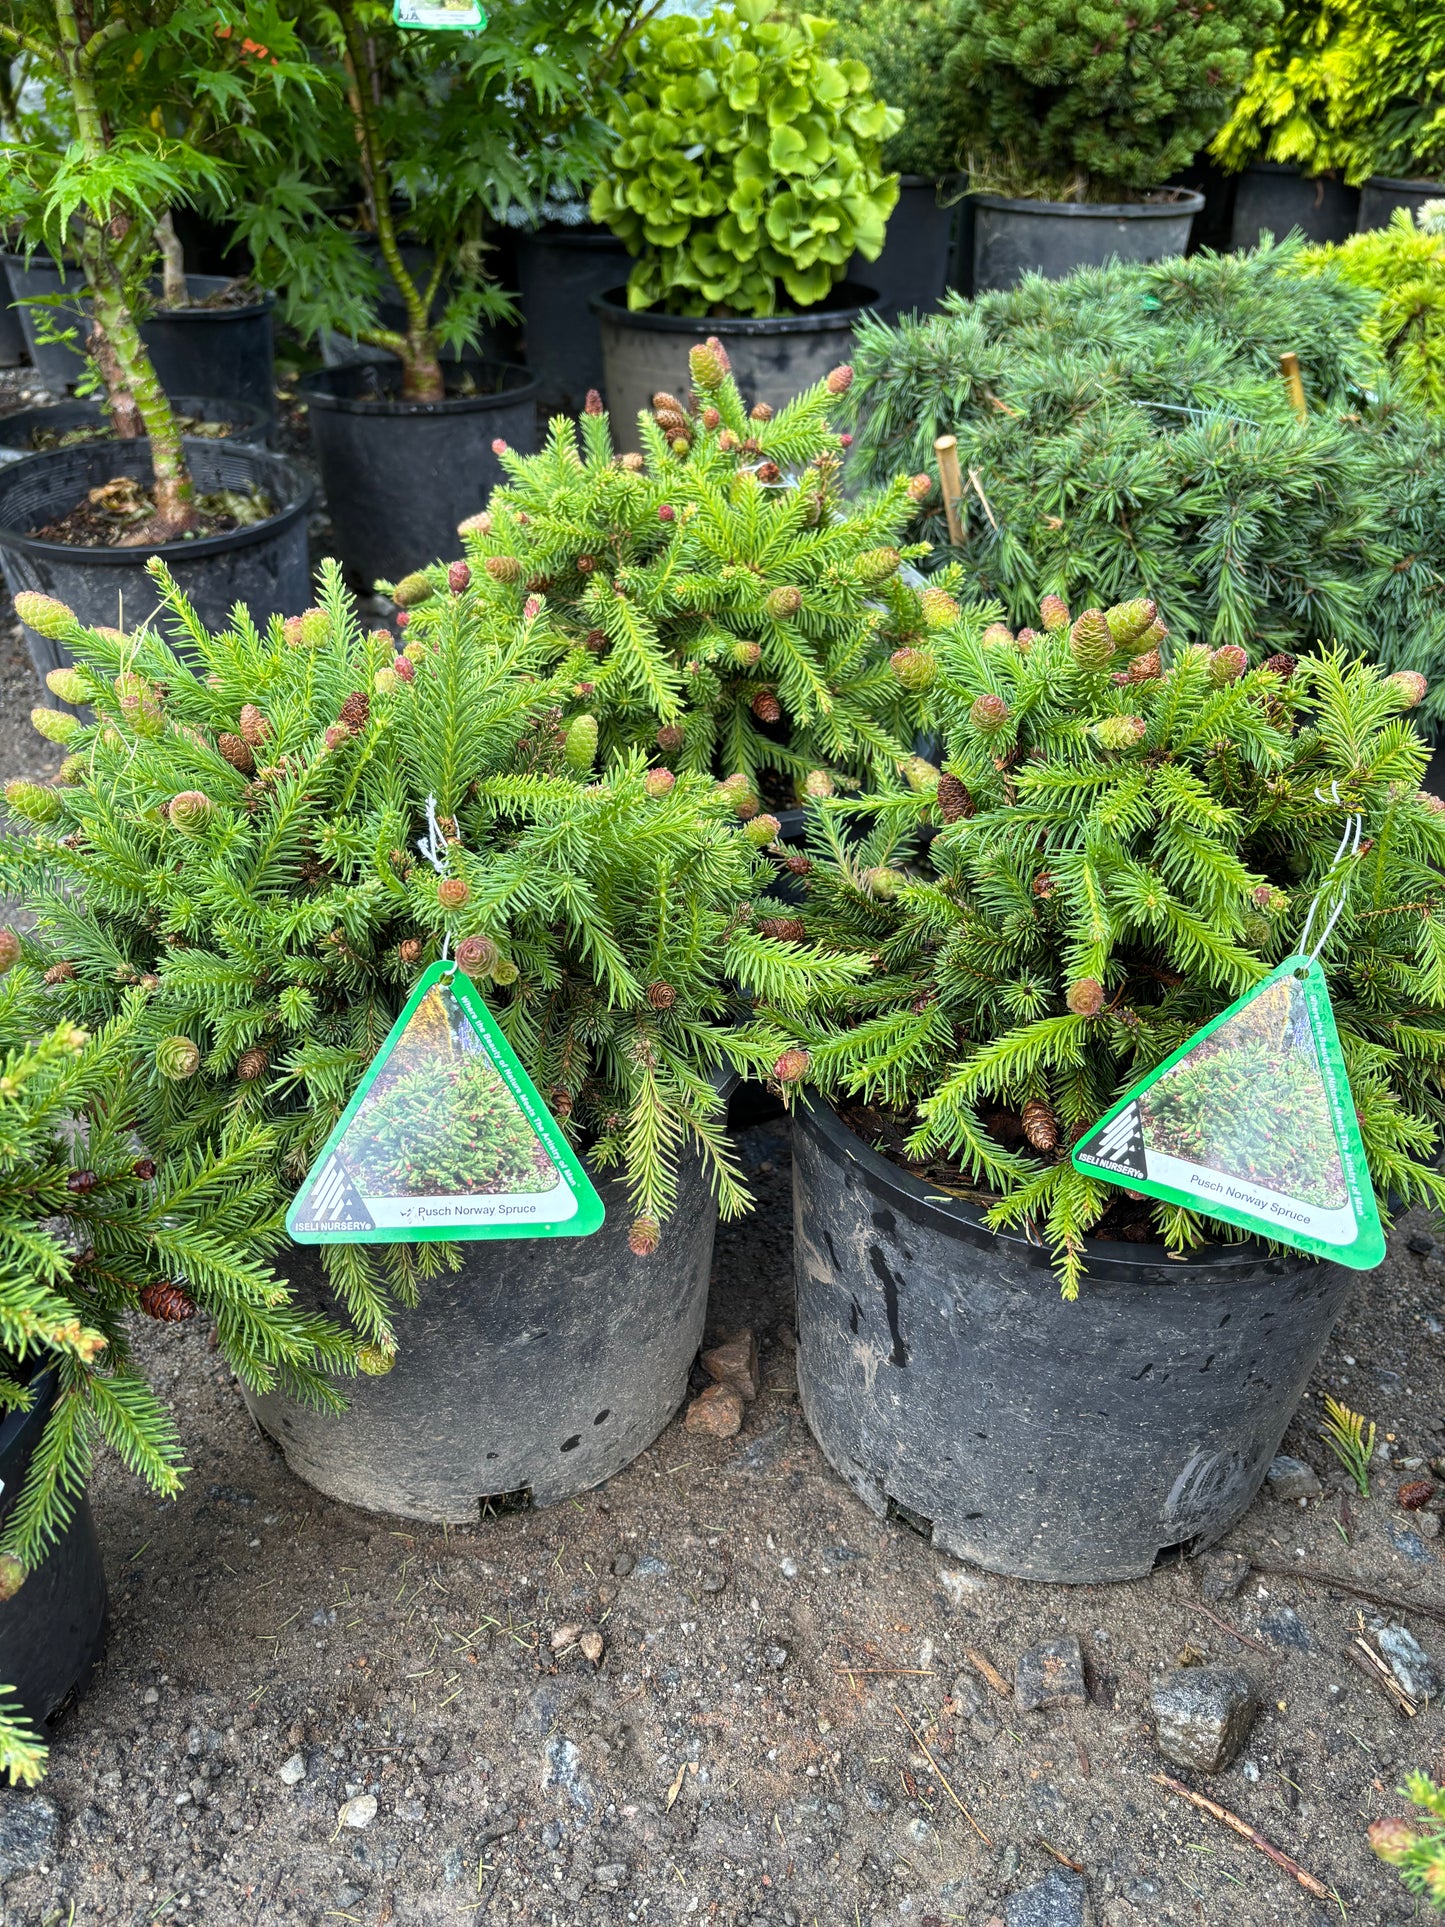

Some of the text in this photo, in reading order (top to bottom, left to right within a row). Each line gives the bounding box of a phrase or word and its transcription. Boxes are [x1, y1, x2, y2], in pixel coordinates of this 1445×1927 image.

[1310, 994, 1320, 1020] Where
[1315, 1021, 1323, 1035] the
[1319, 1036, 1331, 1065] Beauty
[1326, 1066, 1334, 1075] of
[461, 995, 478, 1019] Where
[475, 1020, 486, 1033] the
[483, 1033, 502, 1059] Beauty
[499, 1060, 509, 1068] of
[504, 1068, 522, 1094] Nature
[519, 1094, 536, 1117] Meets
[533, 1117, 544, 1132] The
[541, 1133, 560, 1160] Artistry
[558, 1160, 568, 1169] of
[1328, 1075, 1338, 1105] Nature
[1335, 1106, 1346, 1133] Meets
[1340, 1134, 1349, 1150] The
[1079, 1152, 1100, 1166] ISELI
[1344, 1152, 1357, 1184] Artistry
[1190, 1174, 1311, 1224] Pusch Norway Spruce
[1352, 1185, 1360, 1194] of
[418, 1203, 536, 1217] Pusch Norway Spruce
[295, 1222, 319, 1232] ISELI
